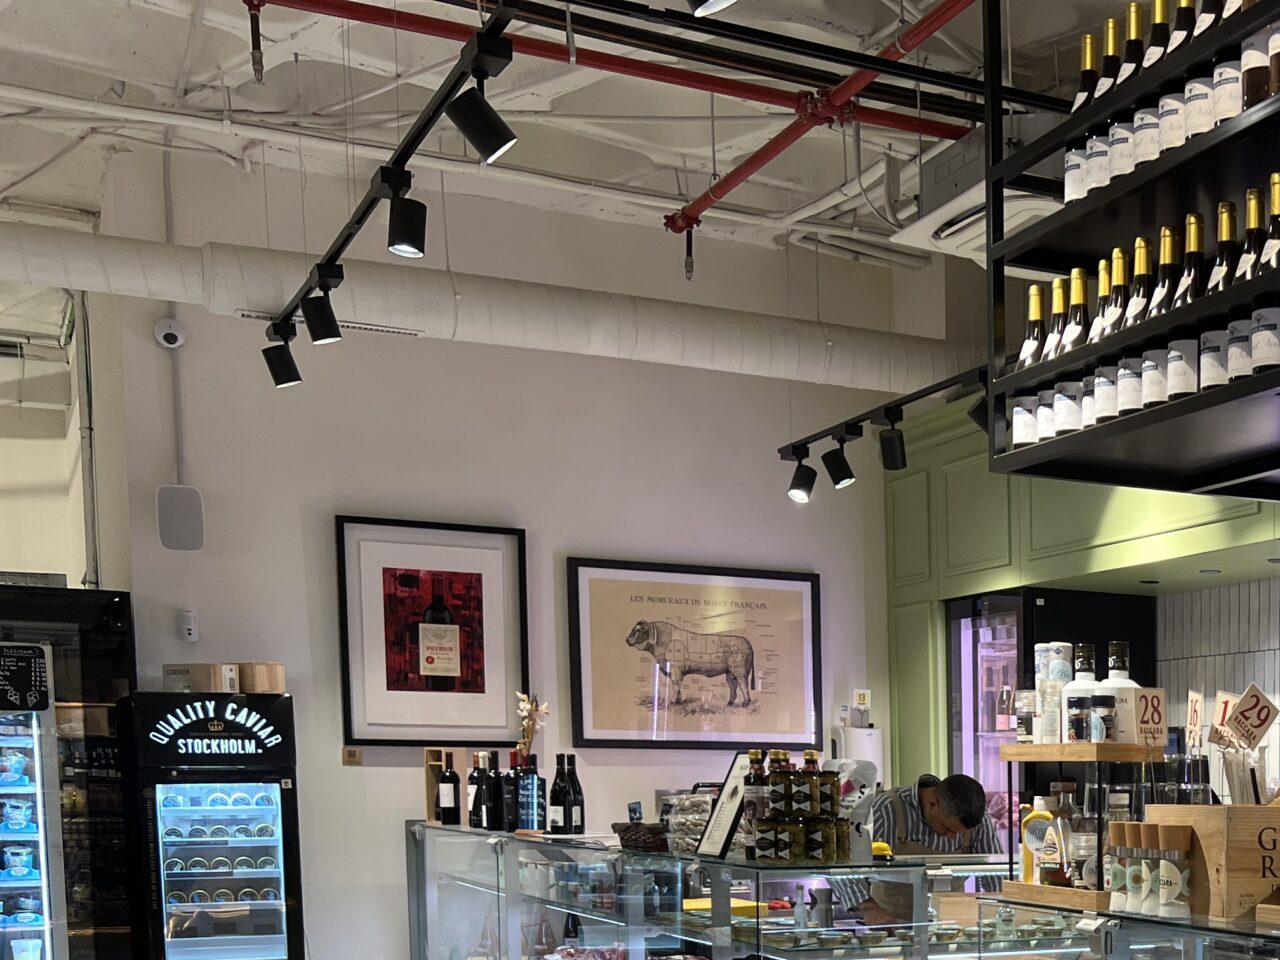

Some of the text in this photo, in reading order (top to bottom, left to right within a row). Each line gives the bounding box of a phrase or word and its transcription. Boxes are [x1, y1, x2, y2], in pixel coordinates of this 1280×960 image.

[630, 595, 644, 603] LES
[1139, 694, 1162, 725] 28
[1189, 699, 1199, 727] 16
[1239, 694, 1271, 729] 29
[149, 700, 283, 748] QUALITY CAVIAR
[1233, 715, 1257, 741] BACCARA
[177, 738, 256, 754] STOCKHOLM
